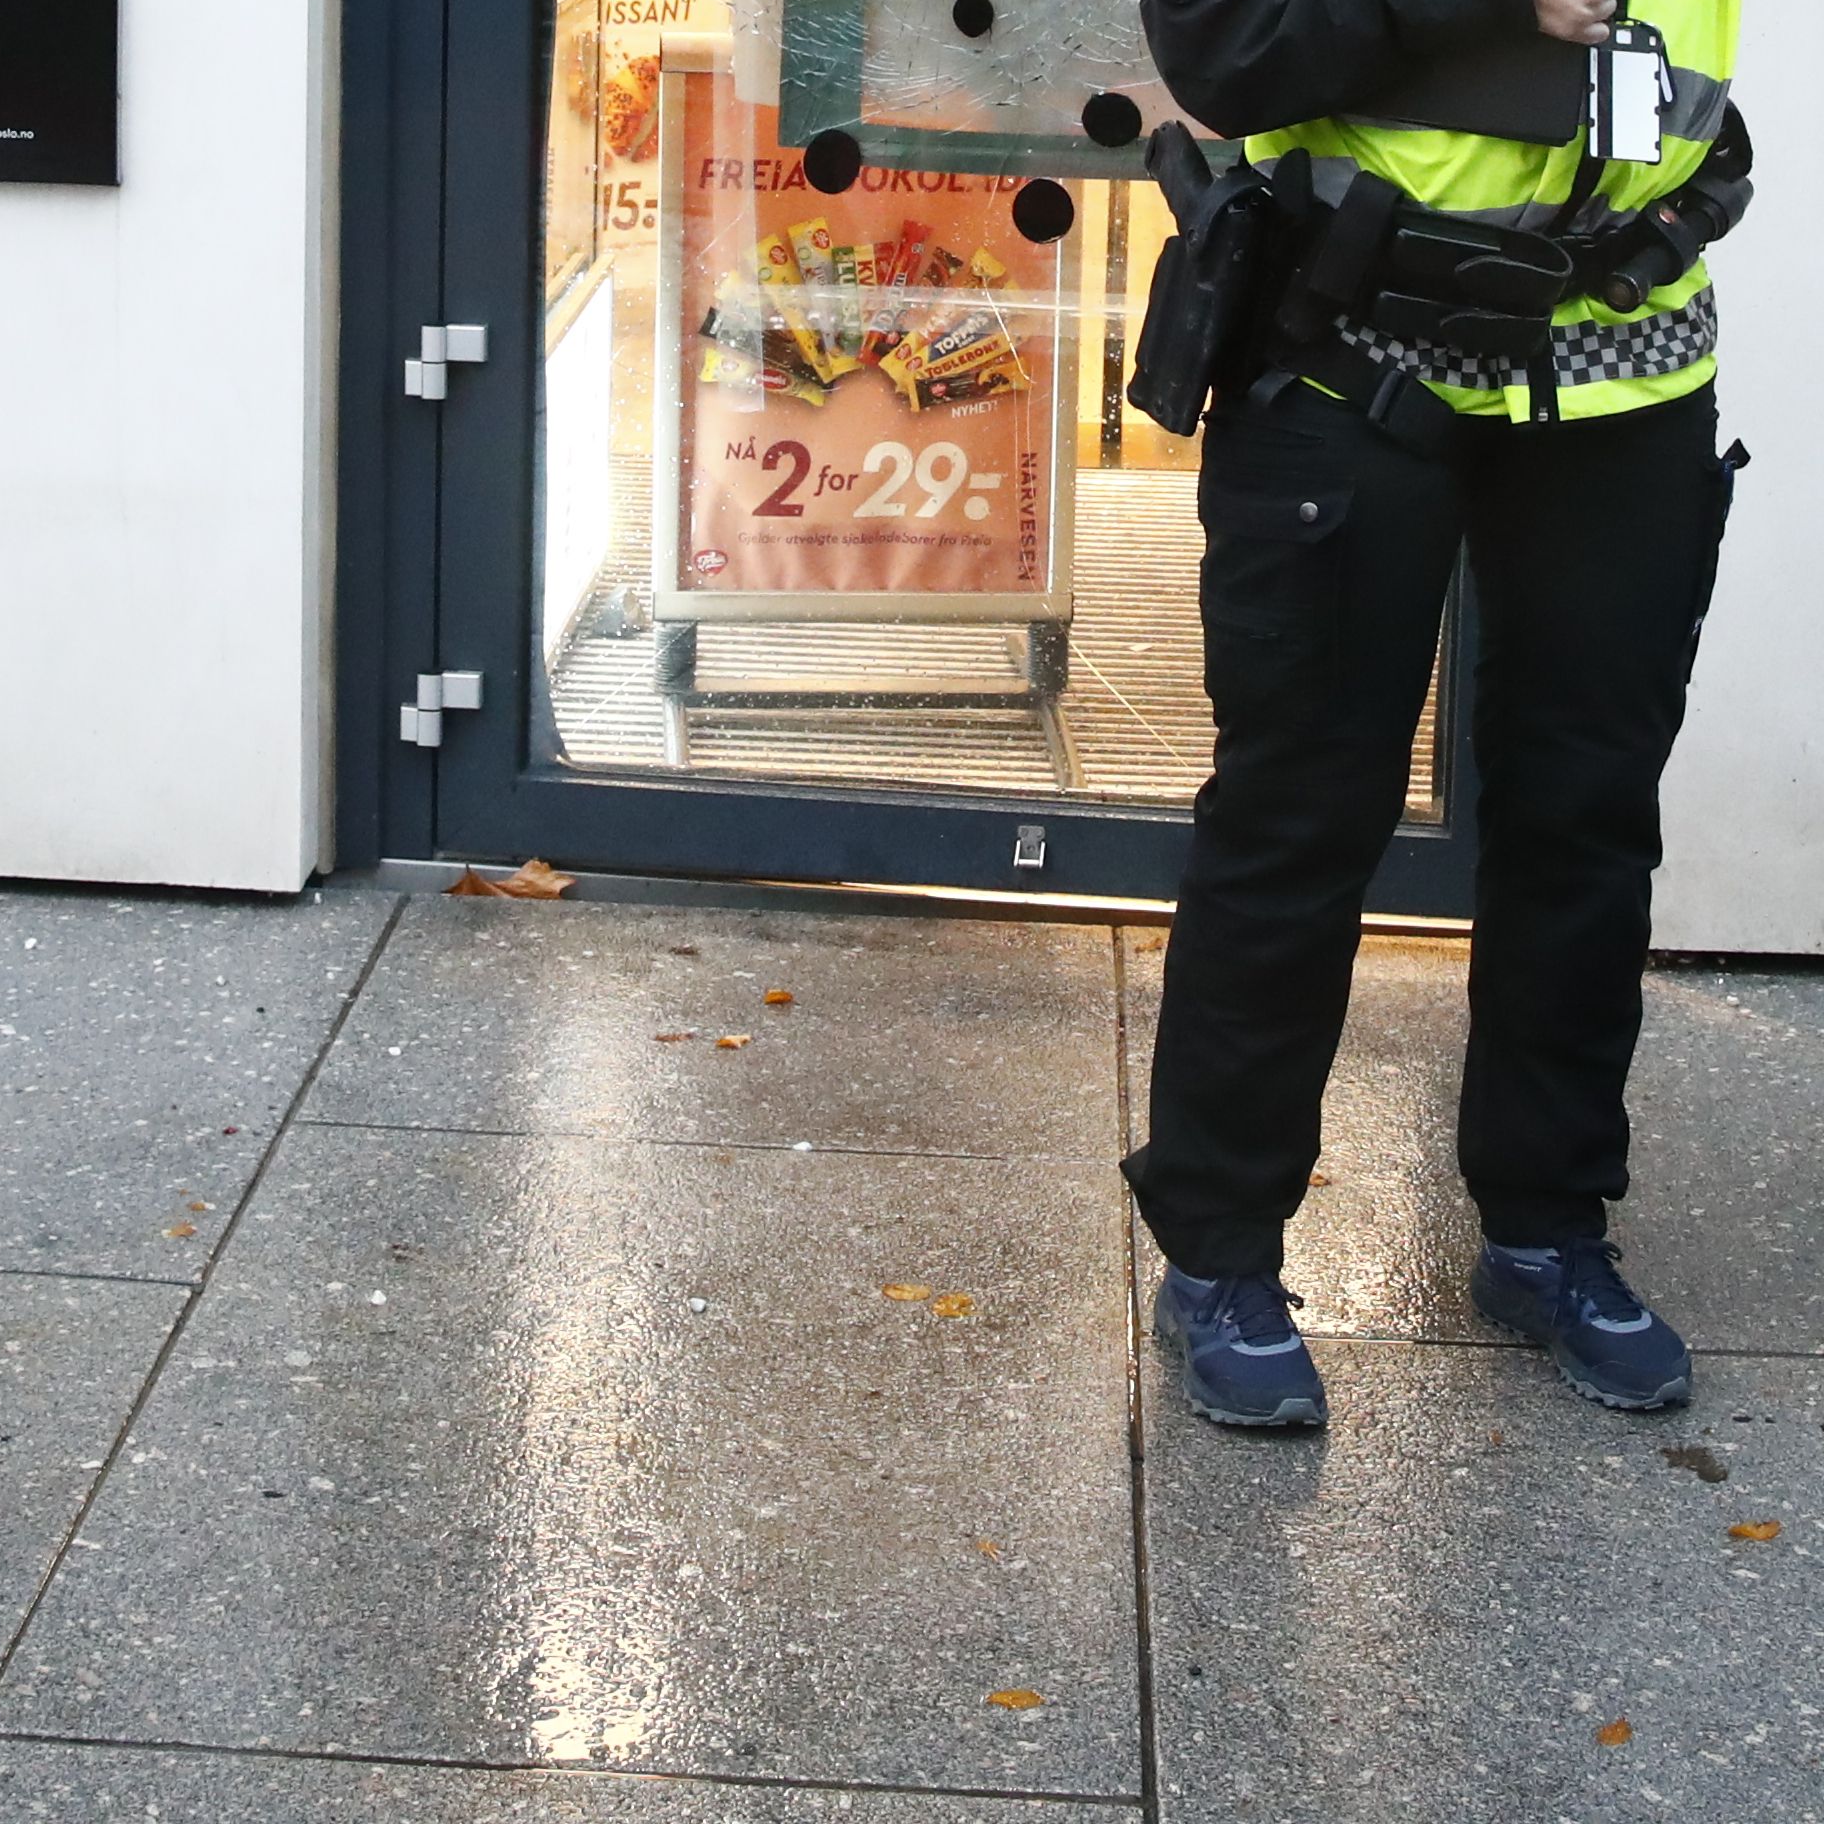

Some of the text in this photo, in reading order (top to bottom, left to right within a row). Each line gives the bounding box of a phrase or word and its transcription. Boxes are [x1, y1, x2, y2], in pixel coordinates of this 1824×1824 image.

[698, 158, 807, 190] FREIA
[925, 341, 1000, 378] TOBLERONE
[725, 438, 758, 462] NÅ
[751, 440, 811, 519] 2
[813, 465, 860, 495] for
[1018, 451, 1040, 583] NARVESEN
[785, 533, 838, 545] utvalgte
